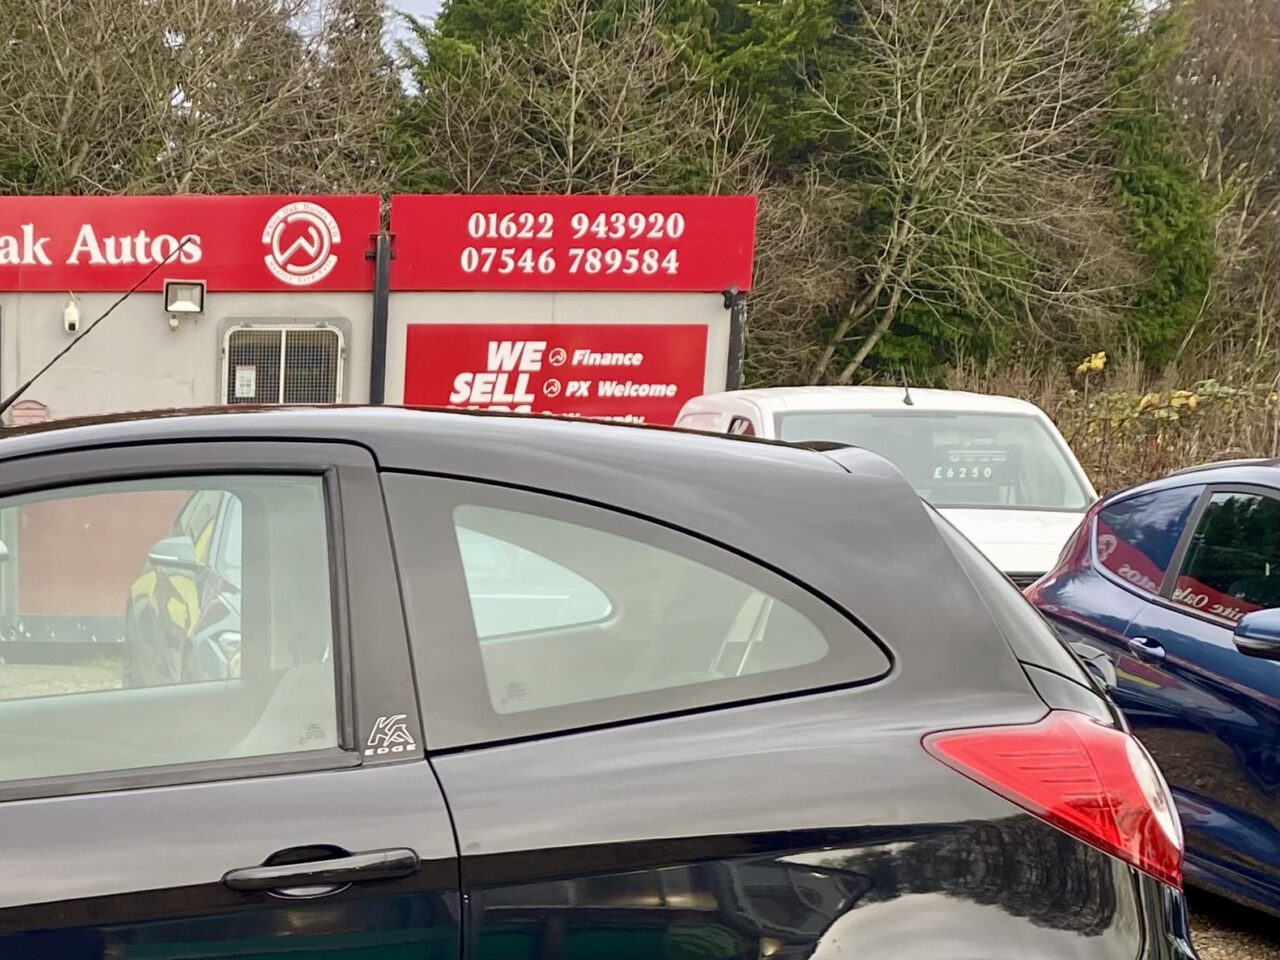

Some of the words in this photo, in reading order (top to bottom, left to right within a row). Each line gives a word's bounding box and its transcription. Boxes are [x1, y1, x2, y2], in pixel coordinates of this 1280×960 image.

[468, 212, 554, 239] 01622
[570, 212, 685, 240] 943920
[66, 223, 203, 267] Autos
[460, 247, 556, 274] 07546
[568, 248, 680, 275] 789584
[487, 341, 547, 371] WE
[571, 349, 643, 367] Finance
[449, 372, 536, 404] SELL
[565, 380, 592, 397] PX
[597, 380, 677, 397] Welcome
[933, 466, 992, 479] £6250
[364, 743, 417, 756] EDGE
